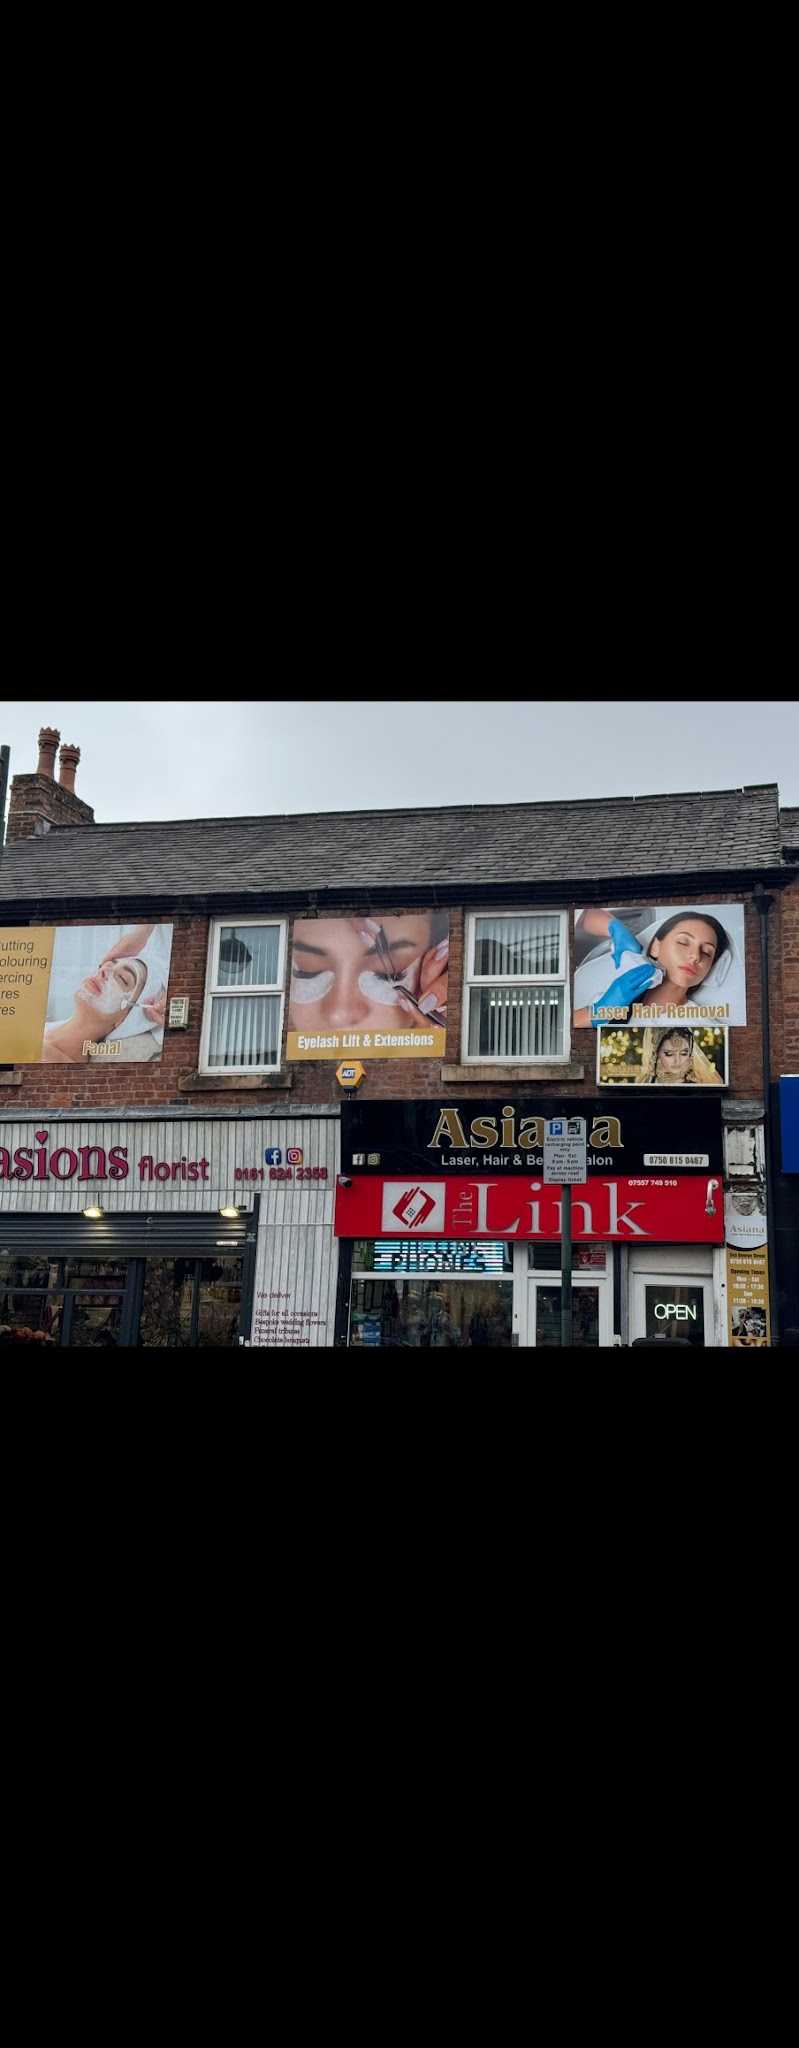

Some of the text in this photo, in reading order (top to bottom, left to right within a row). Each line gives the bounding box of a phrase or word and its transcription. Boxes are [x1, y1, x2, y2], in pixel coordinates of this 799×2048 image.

[0, 940, 34, 953] utting
[589, 1003, 730, 1019] Laser Hair Removal
[82, 1040, 121, 1055] Facial
[297, 1033, 434, 1050] Eyelash Lift & Extensions
[342, 1069, 356, 1077] ADT
[427, 1106, 624, 1148] Asiaa
[441, 1155, 479, 1166] Laser,
[483, 1155, 509, 1165] Hair
[513, 1155, 522, 1165] &
[587, 1155, 613, 1165] alon
[649, 1156, 703, 1165] 0750 815 0467
[138, 1156, 209, 1181] florist
[234, 1167, 264, 1180] 0161
[296, 1167, 328, 1180] 2358
[452, 1191, 473, 1229] The
[467, 1182, 651, 1235] Link
[730, 1225, 764, 1233] Asiana
[654, 1304, 697, 1320] OPEN
[255, 1318, 279, 1326] Bespoke
[281, 1319, 304, 1327] wedding
